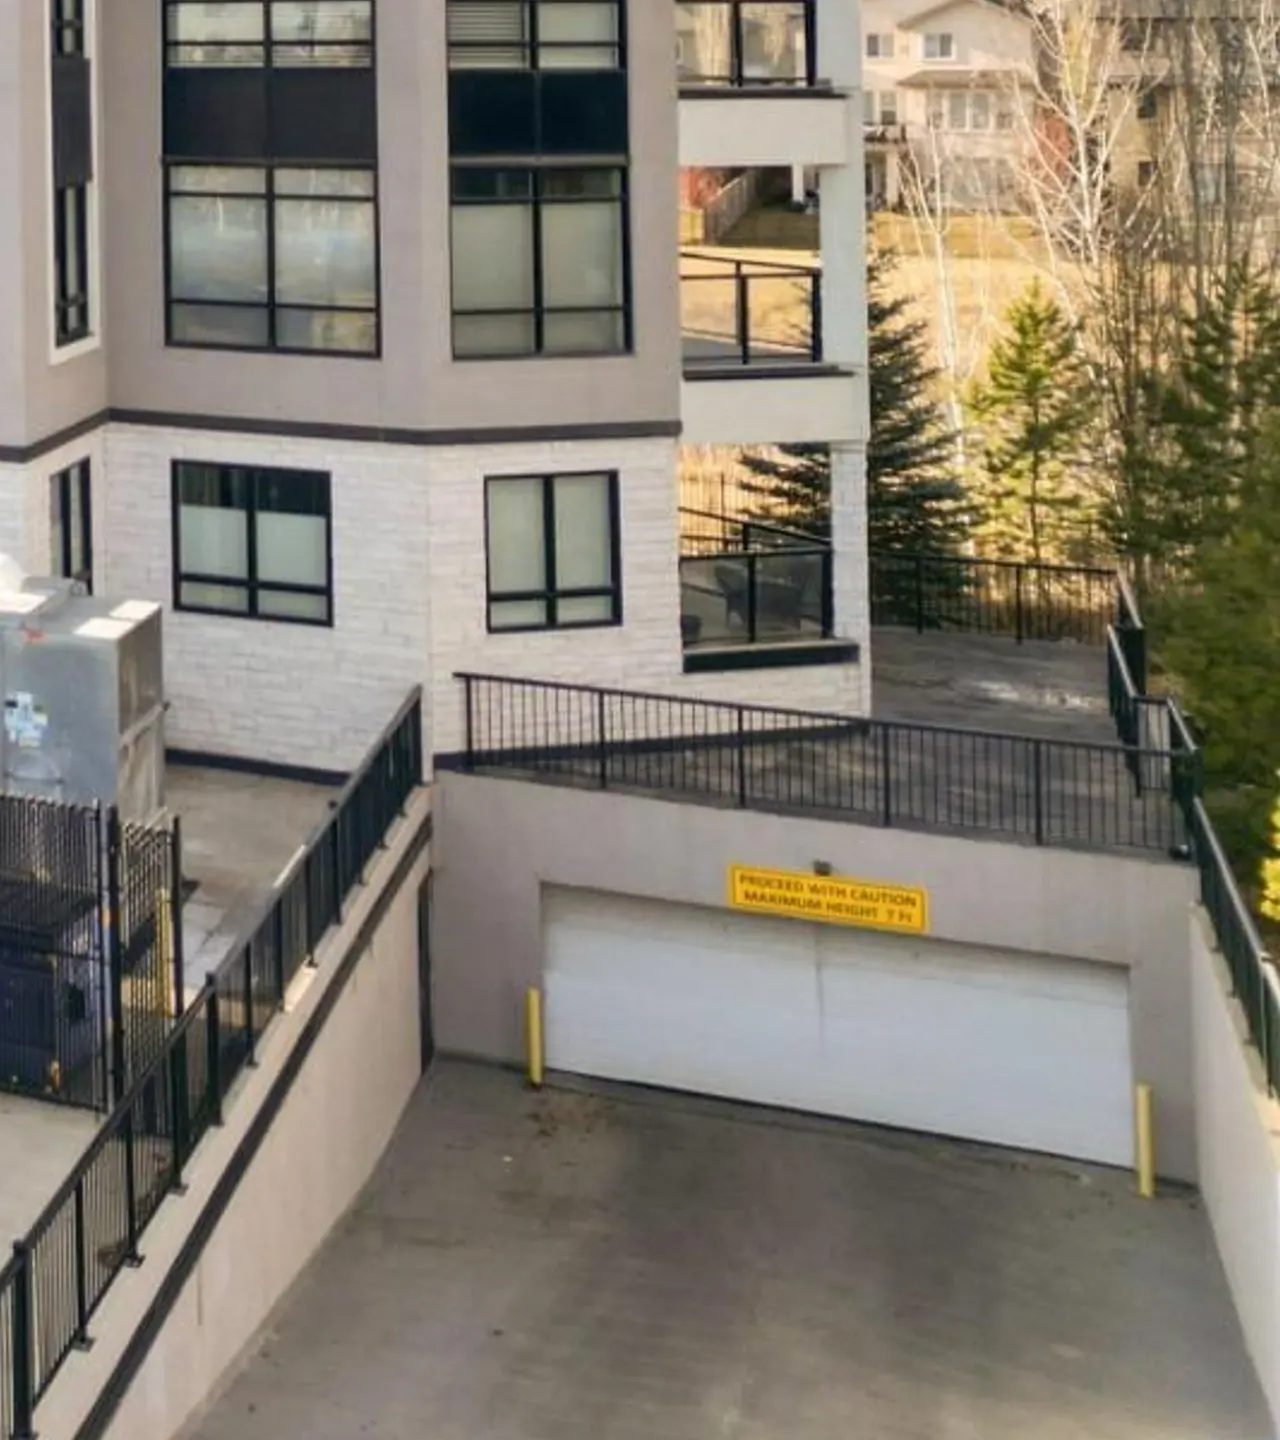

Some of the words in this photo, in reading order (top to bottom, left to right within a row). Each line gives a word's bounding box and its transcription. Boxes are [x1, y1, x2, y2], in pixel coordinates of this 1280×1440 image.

[740, 874, 804, 893] PROCEED
[808, 883, 847, 898] WITH
[850, 888, 917, 908] CAUTION
[744, 891, 821, 910] MAXIMUM
[826, 902, 878, 919] HEIGHT
